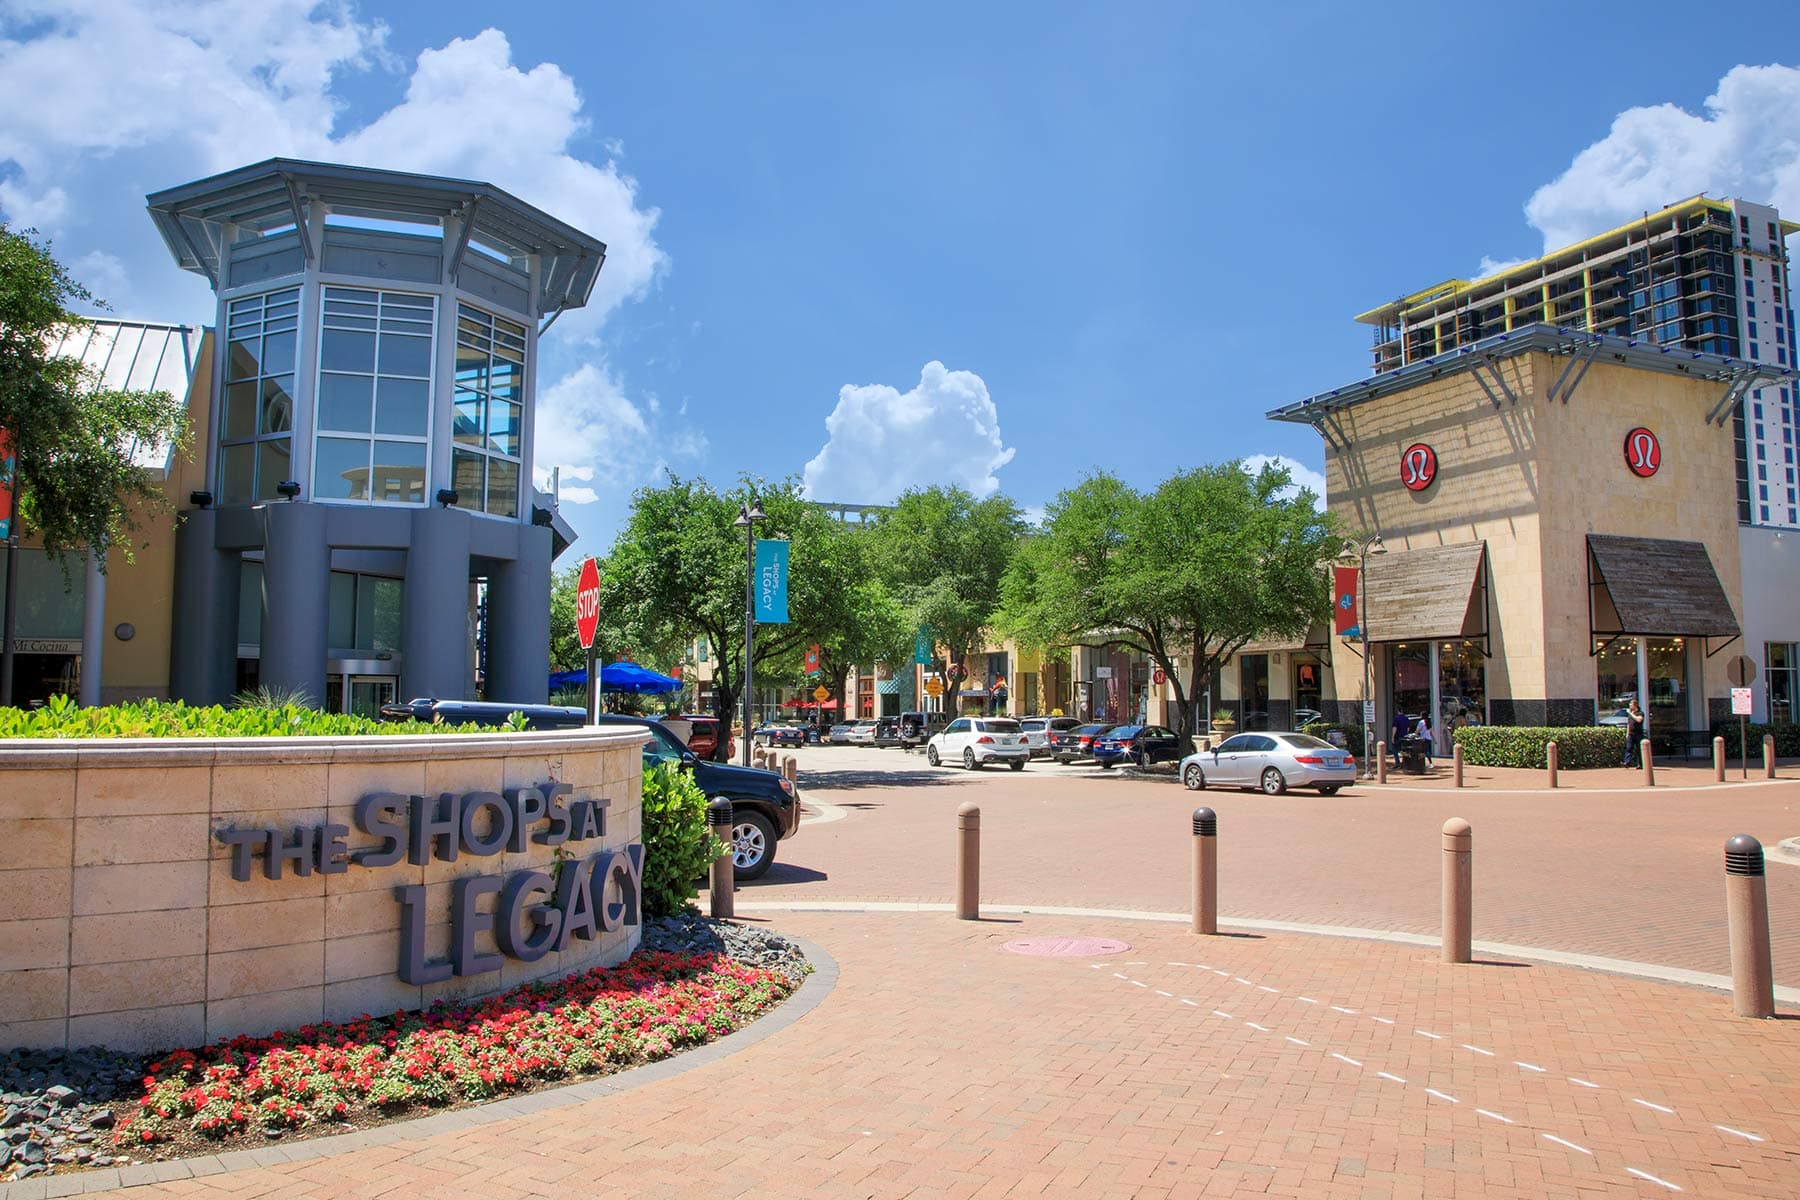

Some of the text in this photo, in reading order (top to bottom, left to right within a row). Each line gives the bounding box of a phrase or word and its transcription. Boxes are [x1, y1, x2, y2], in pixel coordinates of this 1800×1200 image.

[762, 566, 773, 611] LEGACY
[772, 563, 780, 589] SHOPS
[578, 586, 599, 620] STOP
[31, 640, 69, 652] Cocina
[214, 782, 612, 882] THE SHOPS AT
[394, 842, 647, 986] LEGACY
